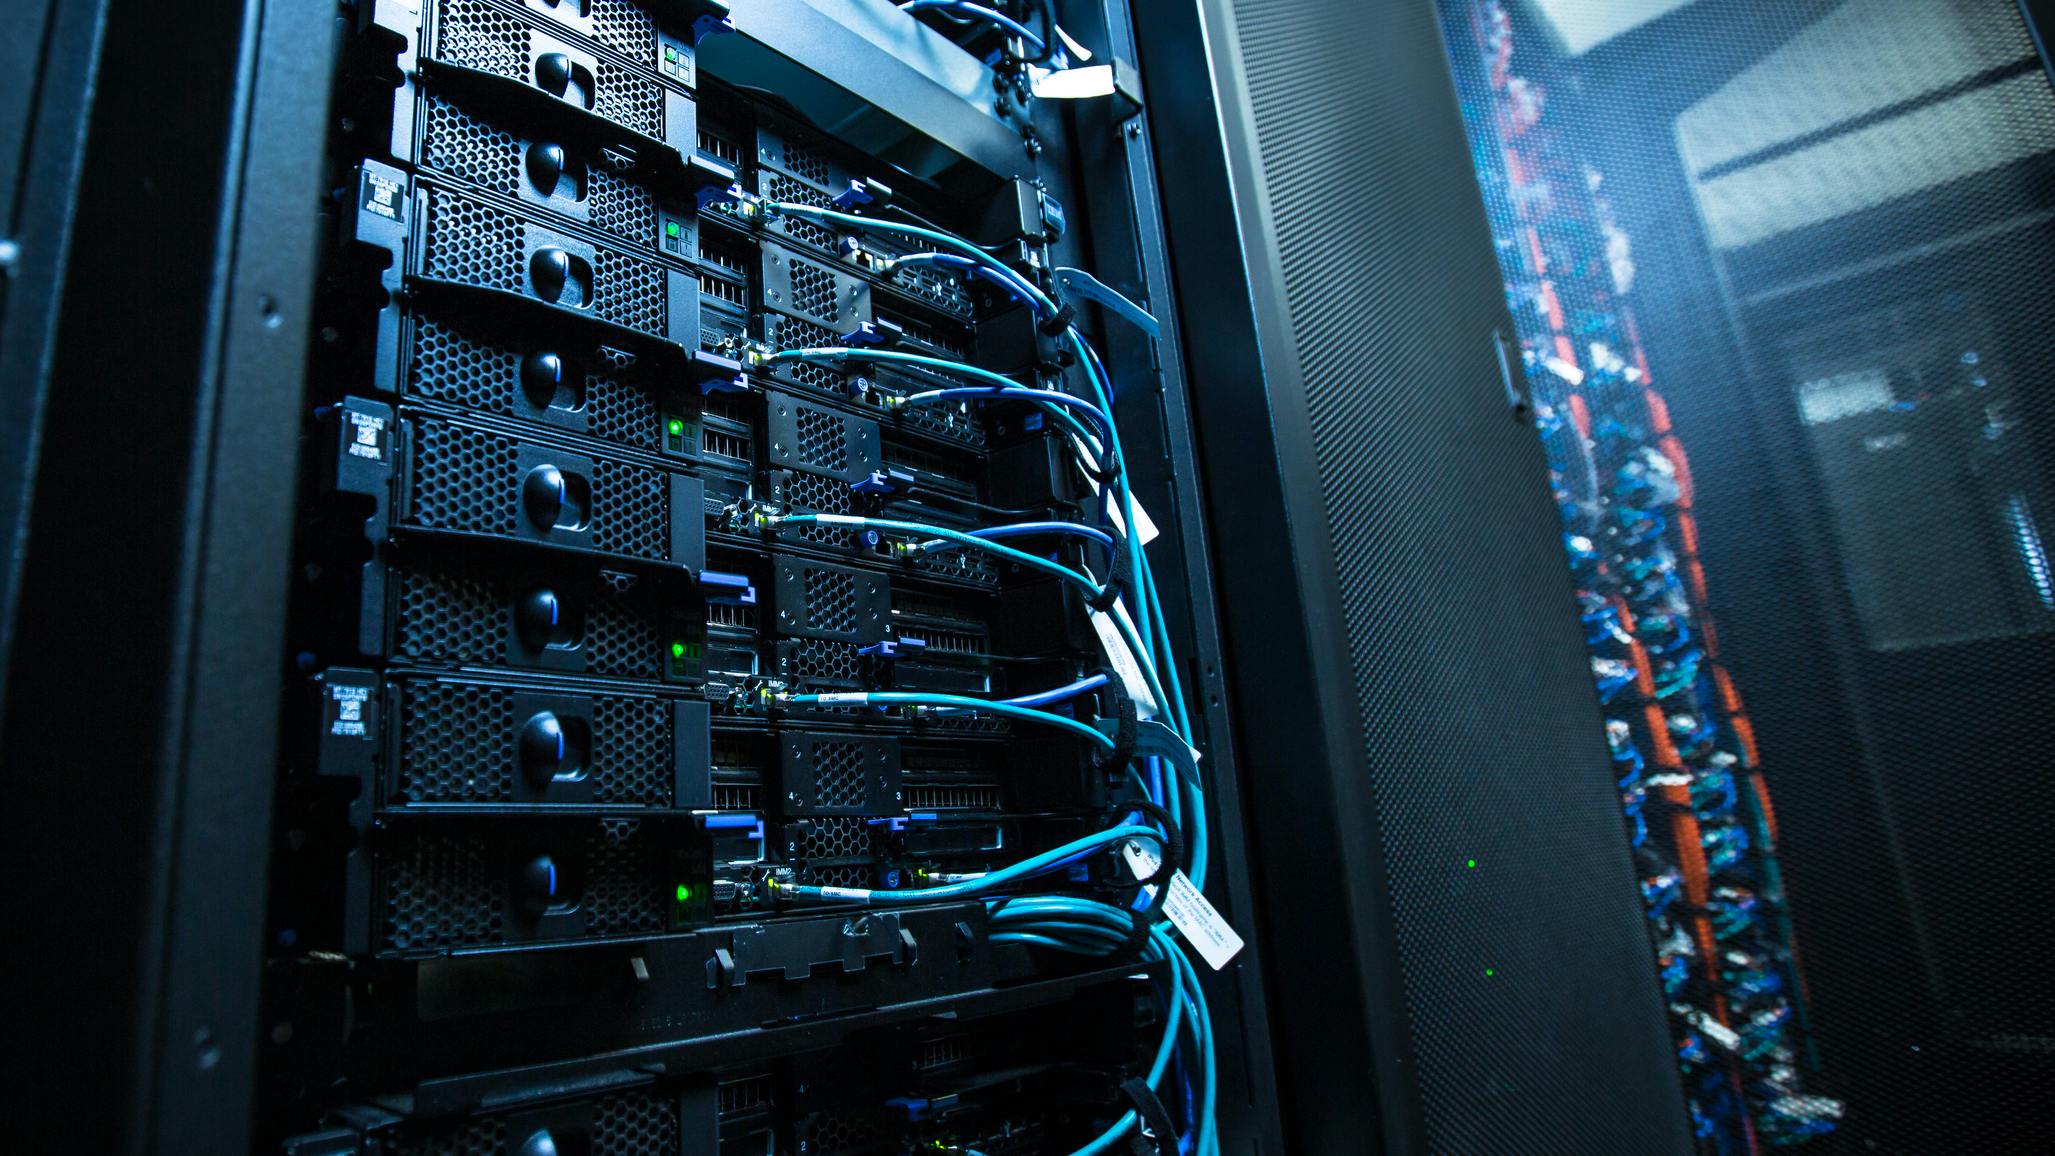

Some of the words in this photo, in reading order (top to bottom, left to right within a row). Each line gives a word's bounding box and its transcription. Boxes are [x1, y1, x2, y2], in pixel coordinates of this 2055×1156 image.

[780, 610, 785, 618] 4
[781, 658, 787, 666] 2
[788, 792, 793, 800] 4
[896, 792, 901, 800] 3
[789, 842, 795, 851] 2
[1175, 875, 1195, 897] Network
[1195, 897, 1212, 916] Access
